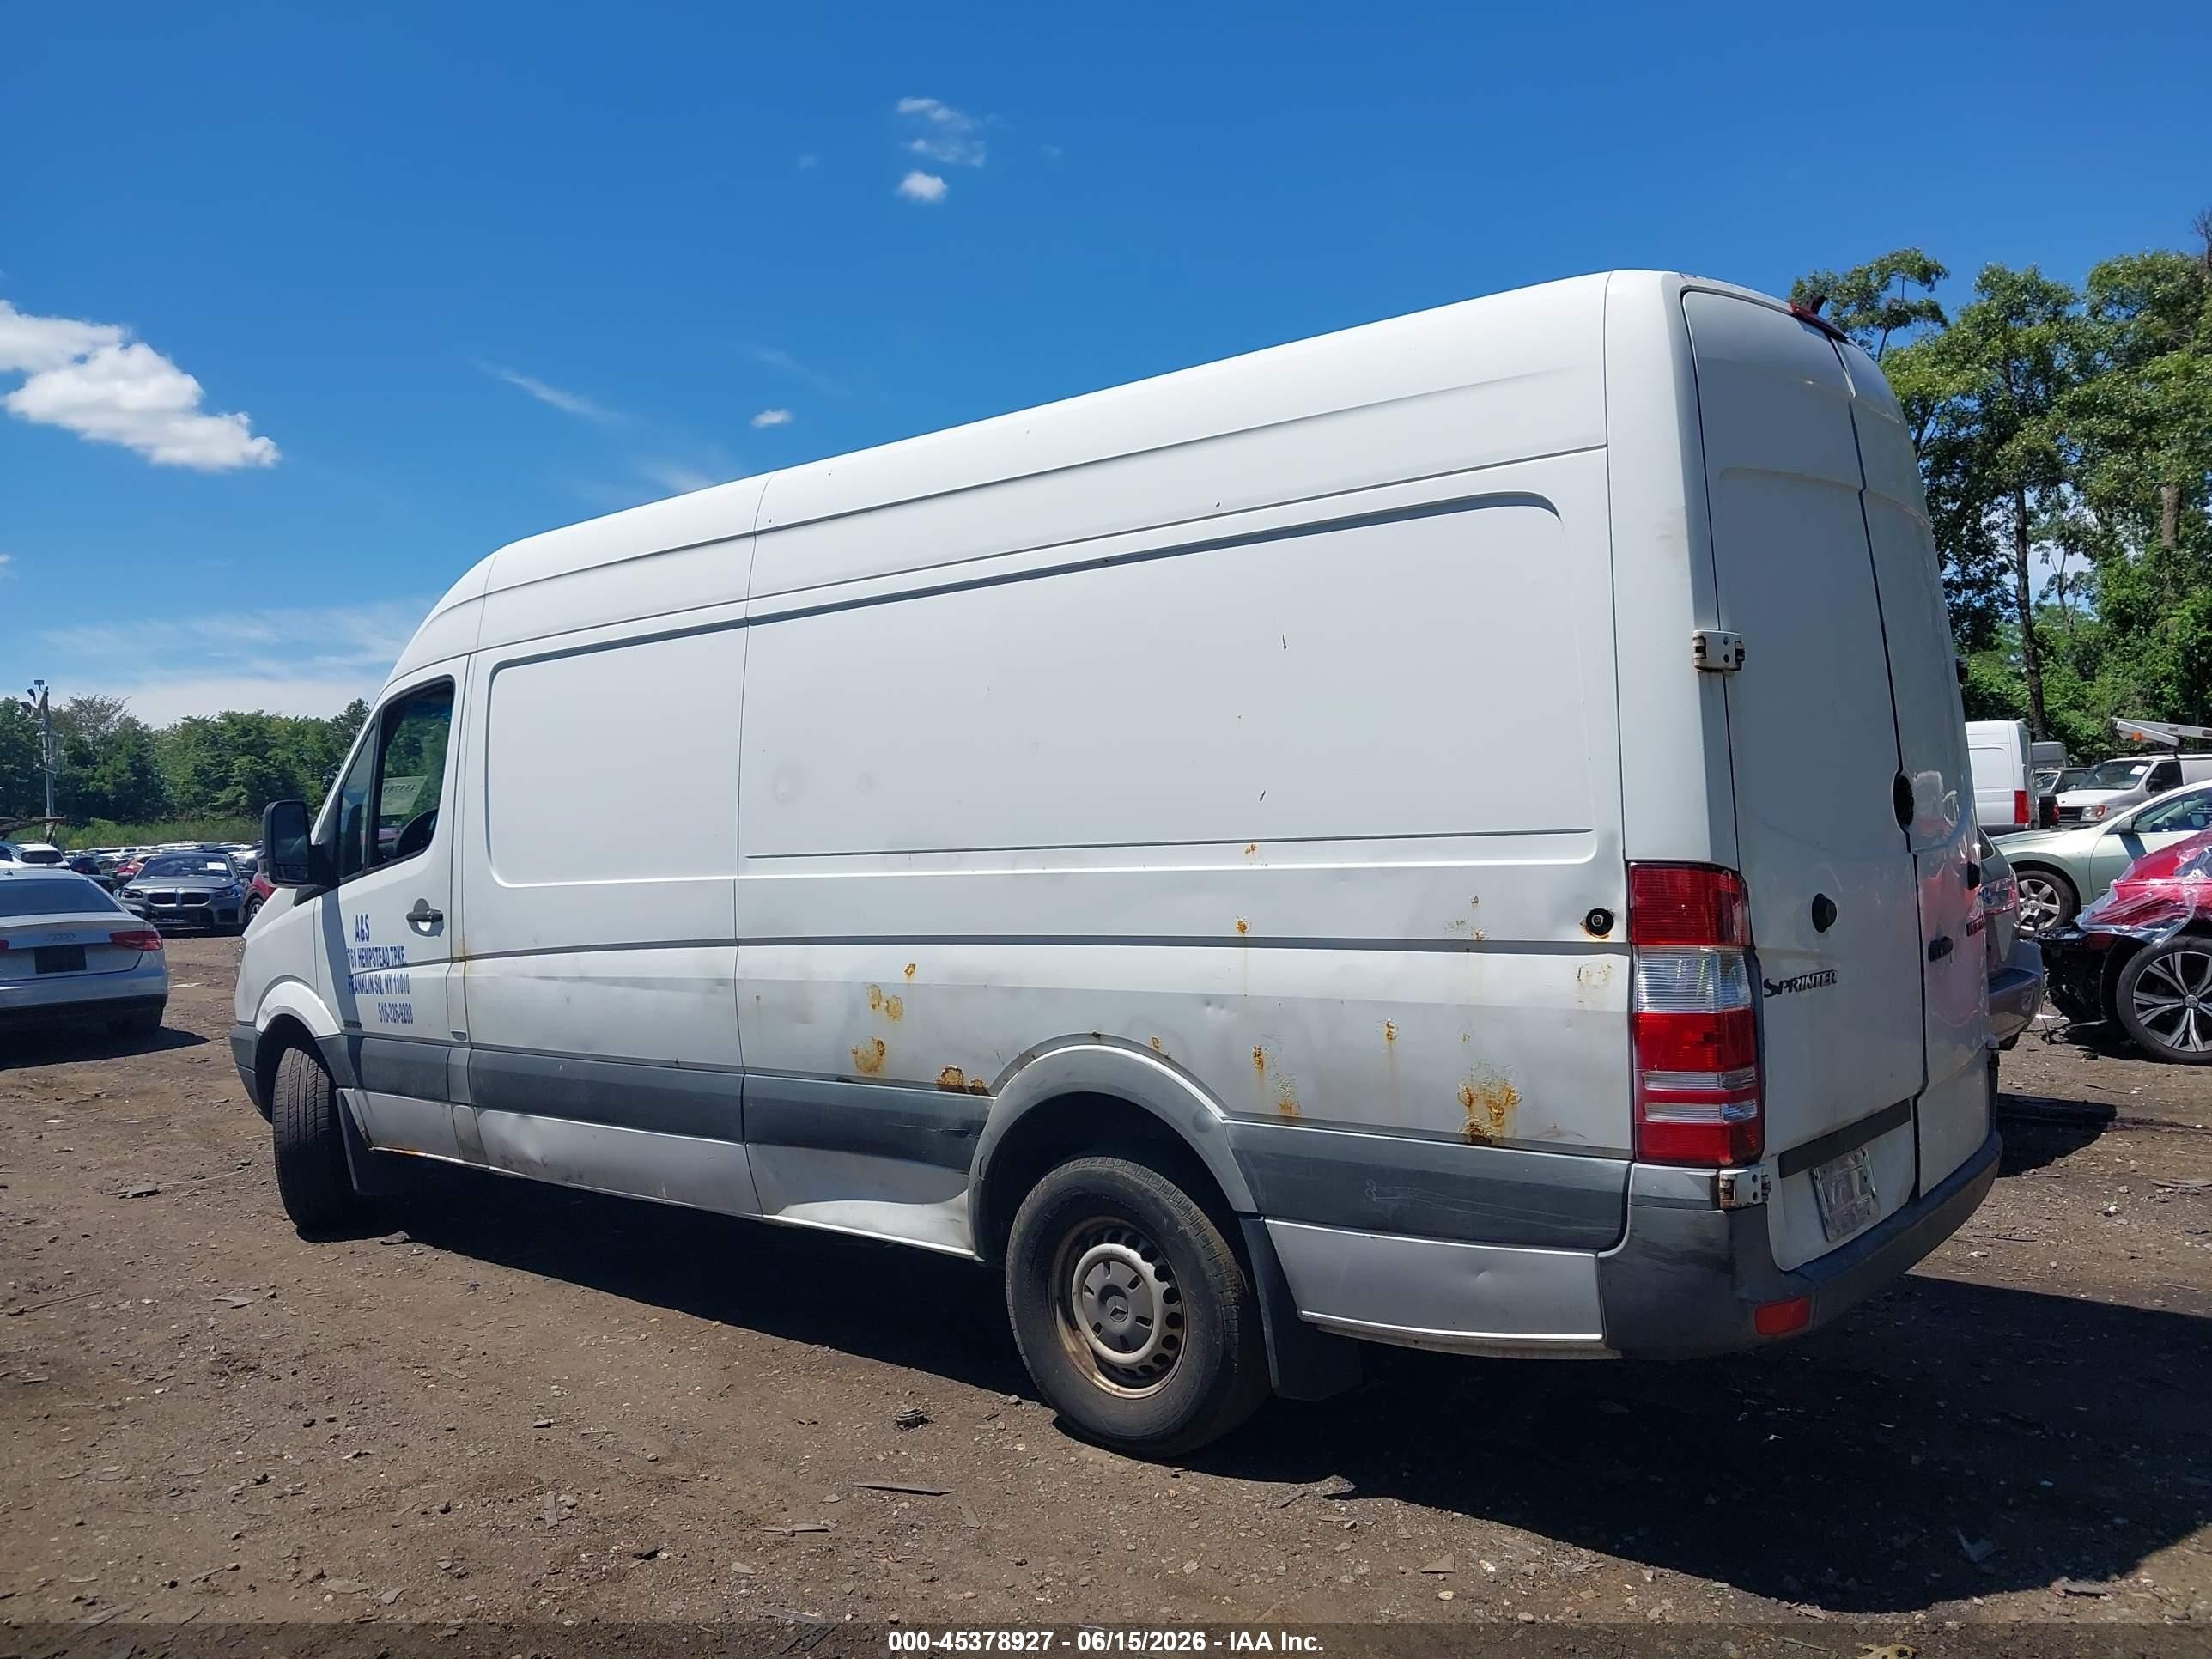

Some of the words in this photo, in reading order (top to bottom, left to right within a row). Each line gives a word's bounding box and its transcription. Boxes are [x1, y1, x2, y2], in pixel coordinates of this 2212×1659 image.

[355, 913, 370, 943] A&S
[357, 946, 390, 968] HEMPSTEAD
[348, 974, 374, 995] FRANKLIN
[385, 973, 392, 995] NY
[393, 973, 410, 995] 11010
[1763, 969, 1838, 998] SPRINTER
